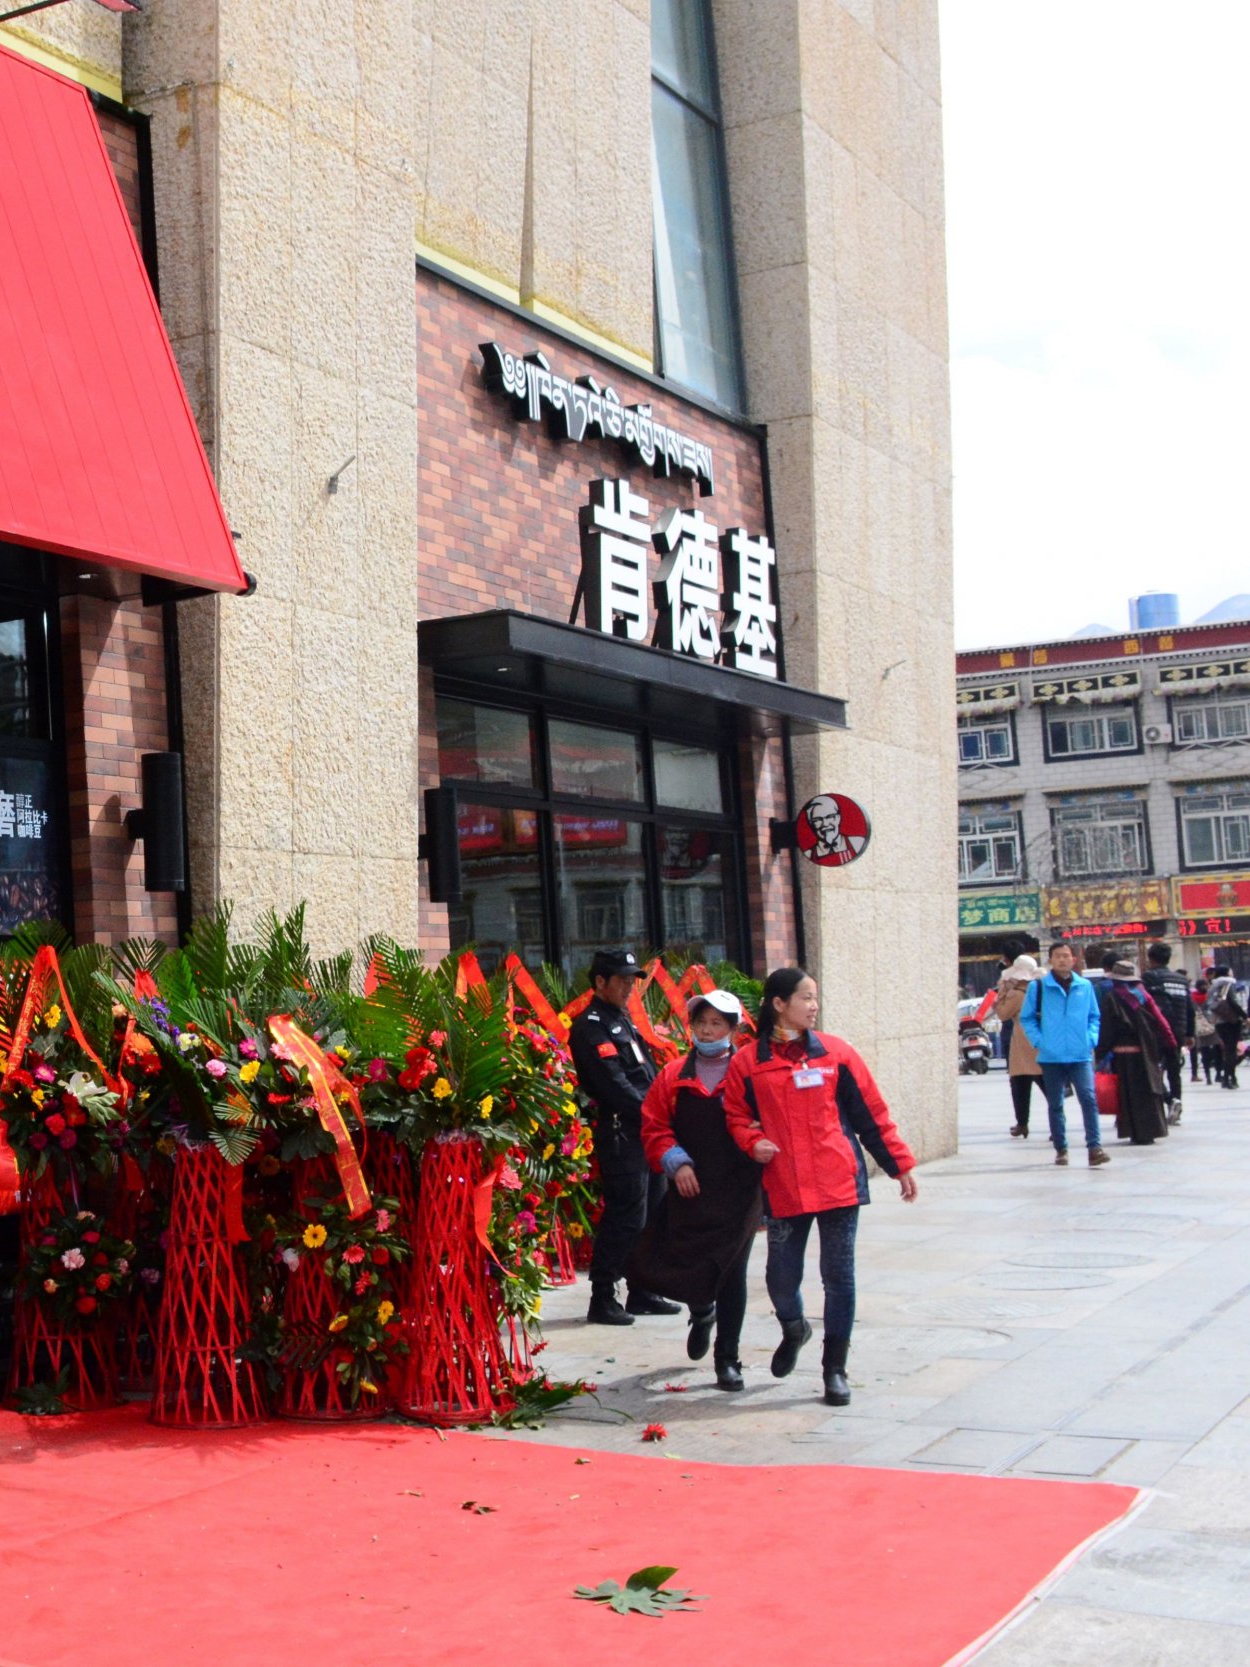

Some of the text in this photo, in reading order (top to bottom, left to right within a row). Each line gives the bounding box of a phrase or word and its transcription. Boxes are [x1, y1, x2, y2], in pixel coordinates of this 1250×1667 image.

[588, 477, 778, 679] 肯德基
[16, 808, 49, 825] 阿拉比卡
[17, 823, 42, 839] 咖啡豆
